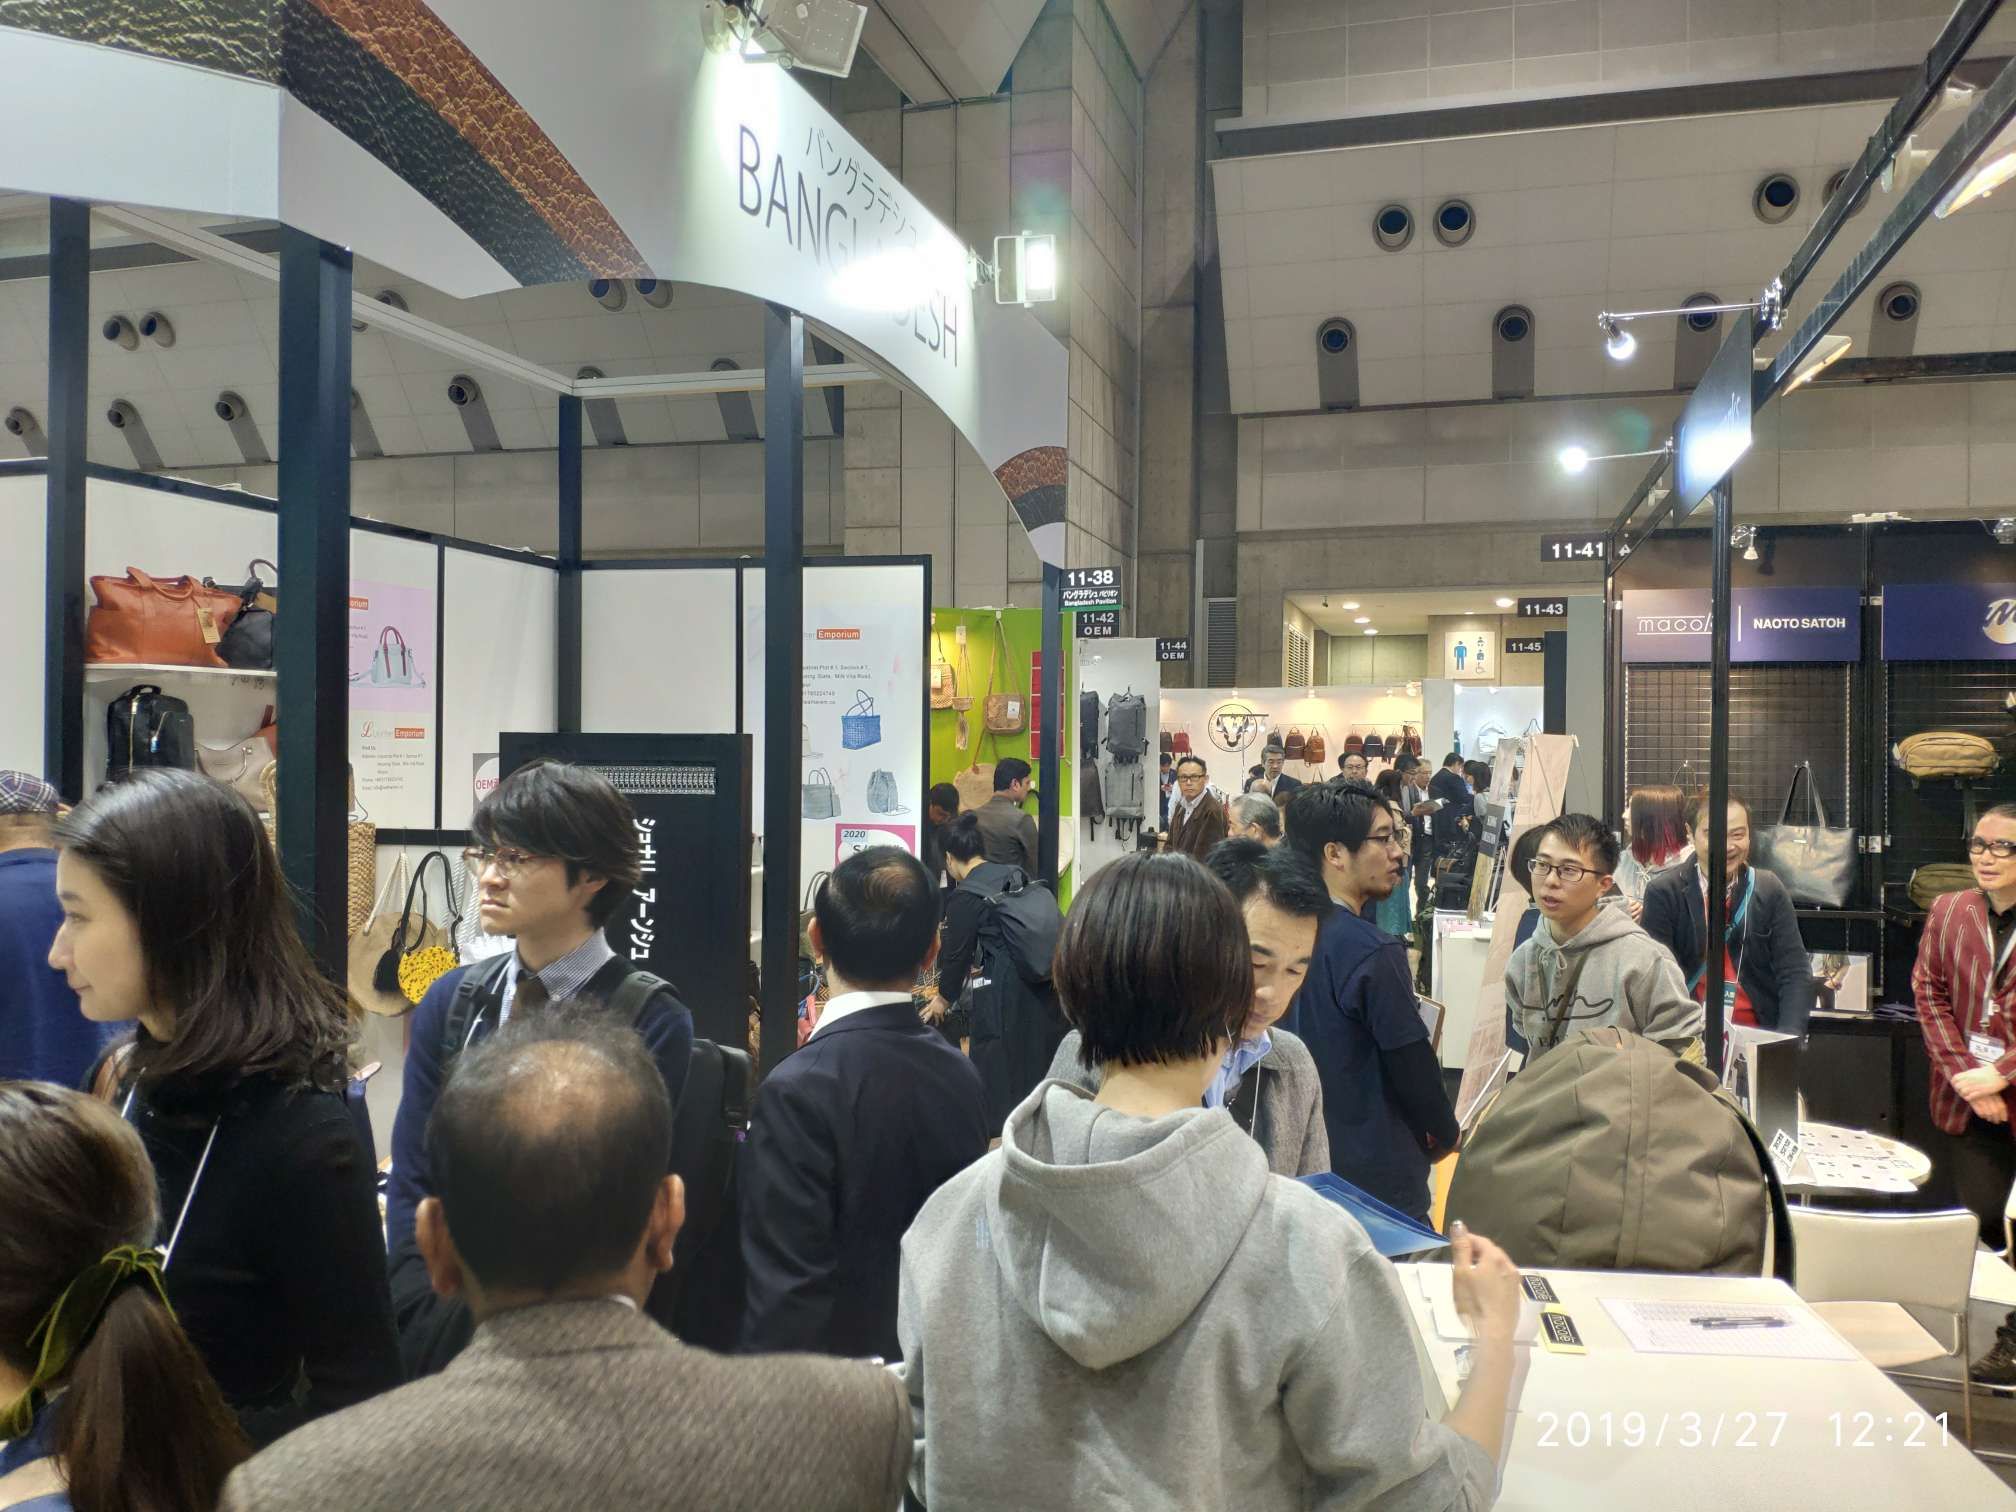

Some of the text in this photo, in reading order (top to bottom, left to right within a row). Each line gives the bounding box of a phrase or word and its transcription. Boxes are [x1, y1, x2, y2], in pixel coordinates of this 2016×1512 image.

[1552, 542, 1604, 558] 11-41
[1068, 569, 1114, 586] 11-38
[351, 599, 368, 608] orium
[1064, 599, 1095, 607] Bangladesh
[1525, 604, 1564, 615] 11-43
[1082, 613, 1115, 624] 11-42
[1753, 617, 1846, 629] NAOTO SATOH
[818, 630, 859, 640] Emporium
[1084, 626, 1112, 636] OEM
[1160, 641, 1188, 650] 11-44
[1511, 642, 1542, 652] 11-45
[1162, 652, 1185, 660] OEM
[843, 830, 866, 838] 2020
